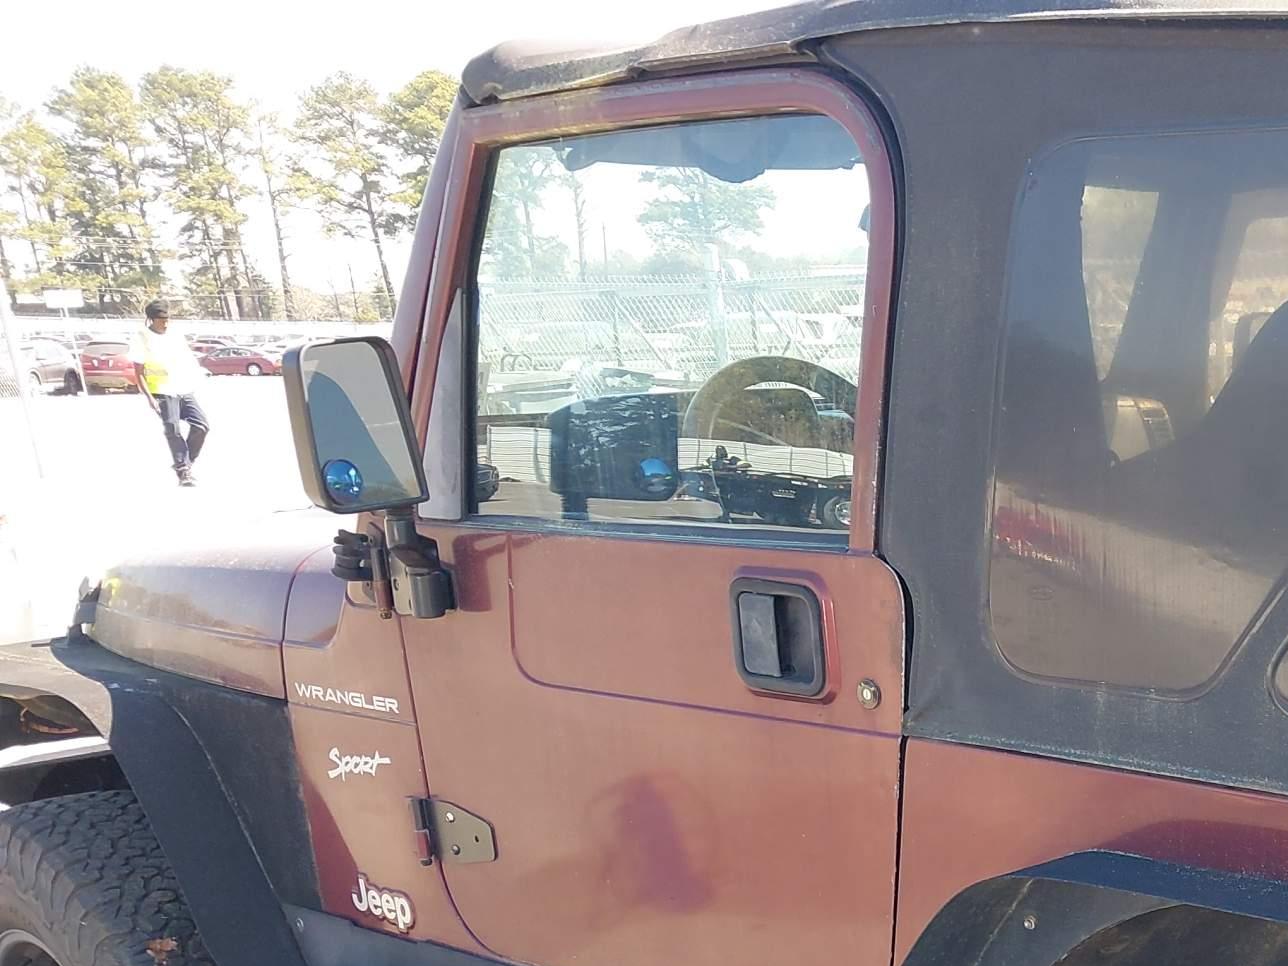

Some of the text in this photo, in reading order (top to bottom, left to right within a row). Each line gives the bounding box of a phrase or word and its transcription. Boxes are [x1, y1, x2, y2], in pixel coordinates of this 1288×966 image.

[295, 682, 400, 714] WRANGLER
[327, 747, 392, 782] Sport
[351, 877, 412, 930] Jeep
